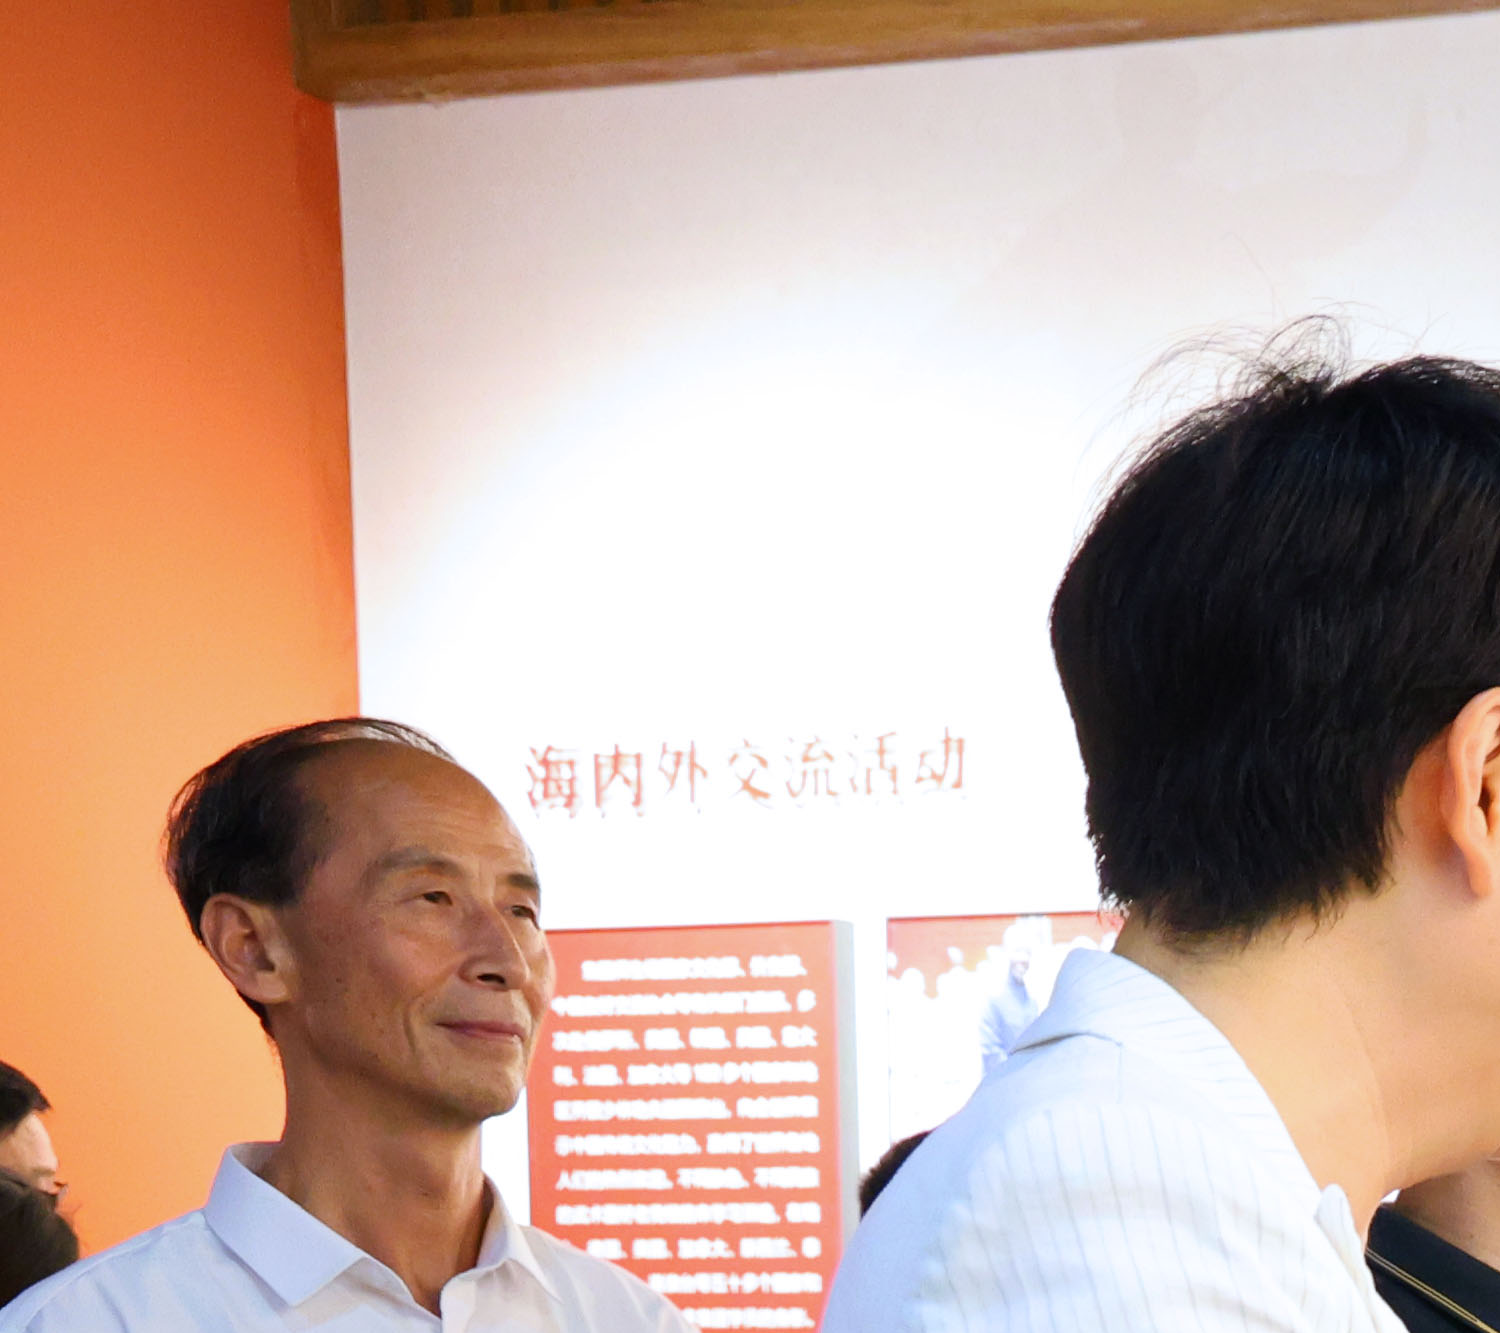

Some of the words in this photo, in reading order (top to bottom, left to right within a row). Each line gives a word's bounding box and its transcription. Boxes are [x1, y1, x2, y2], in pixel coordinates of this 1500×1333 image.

[527, 727, 966, 817] 海内外交流活动
